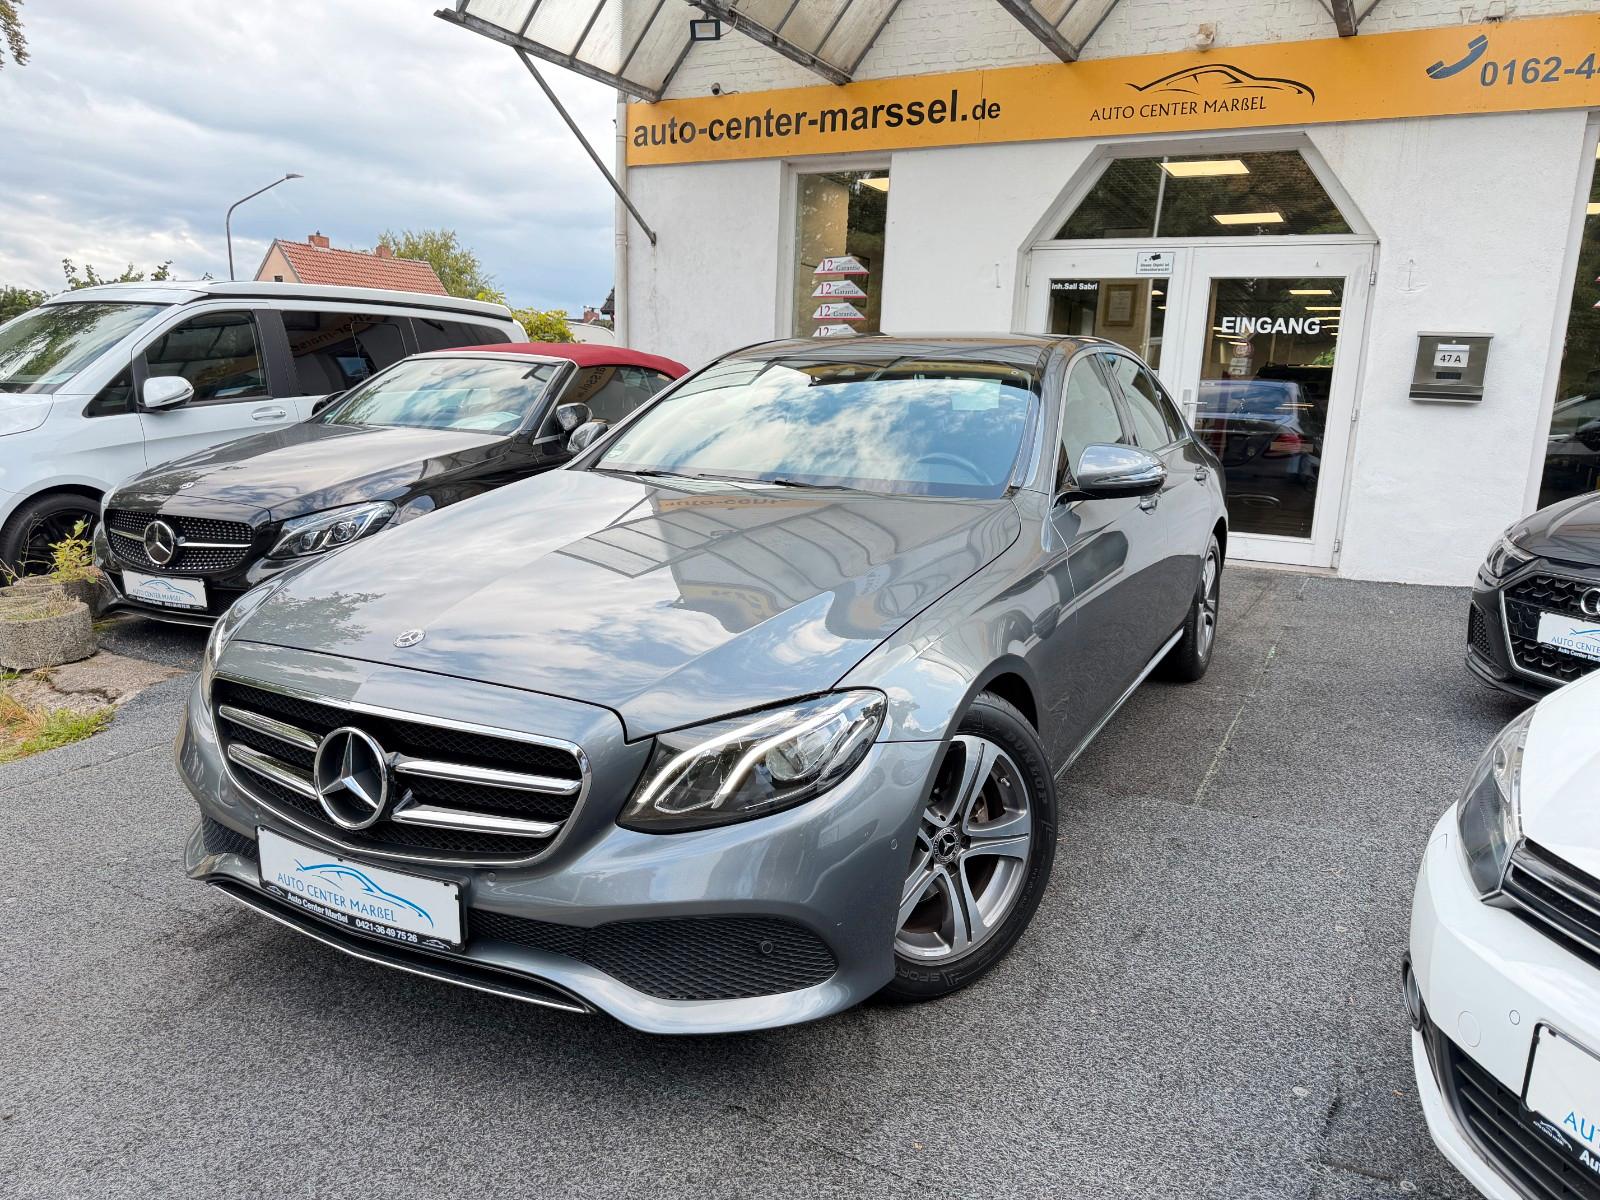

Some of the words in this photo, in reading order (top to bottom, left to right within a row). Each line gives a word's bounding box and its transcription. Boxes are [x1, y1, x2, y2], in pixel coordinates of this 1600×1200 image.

[1480, 53, 1600, 86] 0162-4
[633, 89, 1001, 147] auto-center-marssel.de
[1090, 105, 1135, 121] AUTO
[1139, 101, 1198, 118] CENTER
[1203, 96, 1267, 114] MARßEL
[821, 259, 833, 272] 12
[820, 283, 832, 295] 12
[819, 305, 831, 317] 12
[818, 326, 830, 337] 12
[1221, 316, 1320, 335] EINGANG
[1440, 354, 1453, 363] 47
[1453, 354, 1462, 363] A
[1551, 636, 1574, 647] AUTO
[277, 872, 304, 892] AUTO
[307, 884, 347, 908] CENTER
[287, 892, 302, 905] Auto
[302, 899, 325, 915] Center
[355, 918, 386, 935] 0421-36
[386, 927, 396, 937] 49
[396, 930, 407, 940] 75
[406, 933, 418, 943] 26
[1563, 1111, 1600, 1148] AU
